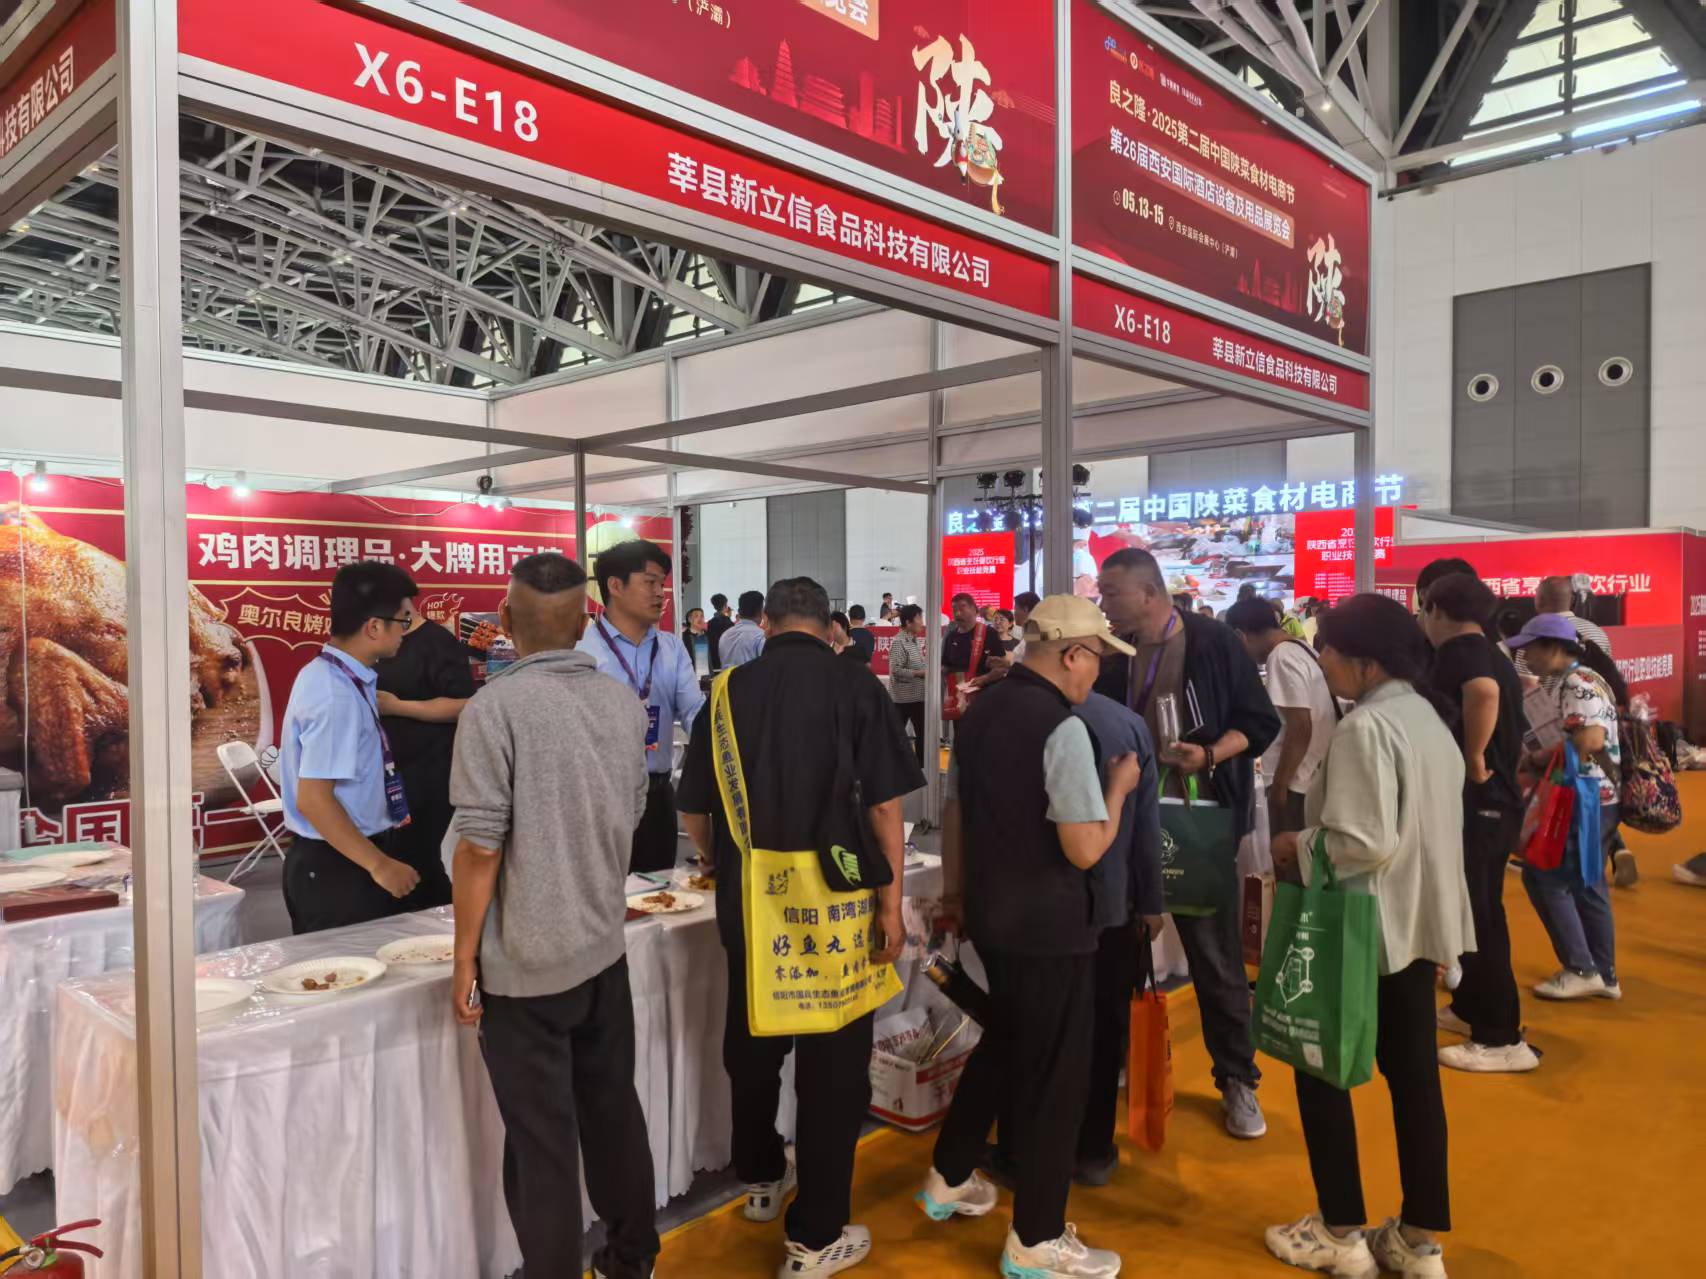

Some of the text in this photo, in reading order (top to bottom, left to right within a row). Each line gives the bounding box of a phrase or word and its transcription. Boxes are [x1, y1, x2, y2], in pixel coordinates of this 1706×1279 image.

[354, 42, 539, 142] X6-E18
[1110, 127, 1290, 240] 第26届西安国际酒店设备及用品展览会
[1122, 189, 1164, 226] 05.13-15
[667, 152, 990, 288] 莘县新立信食品科技有限公司
[1114, 304, 1170, 344] X6-E18
[1212, 336, 1337, 395] 莘县新立信食品科技有限公司
[427, 601, 445, 610] HOT
[784, 907, 818, 925] 信阳
